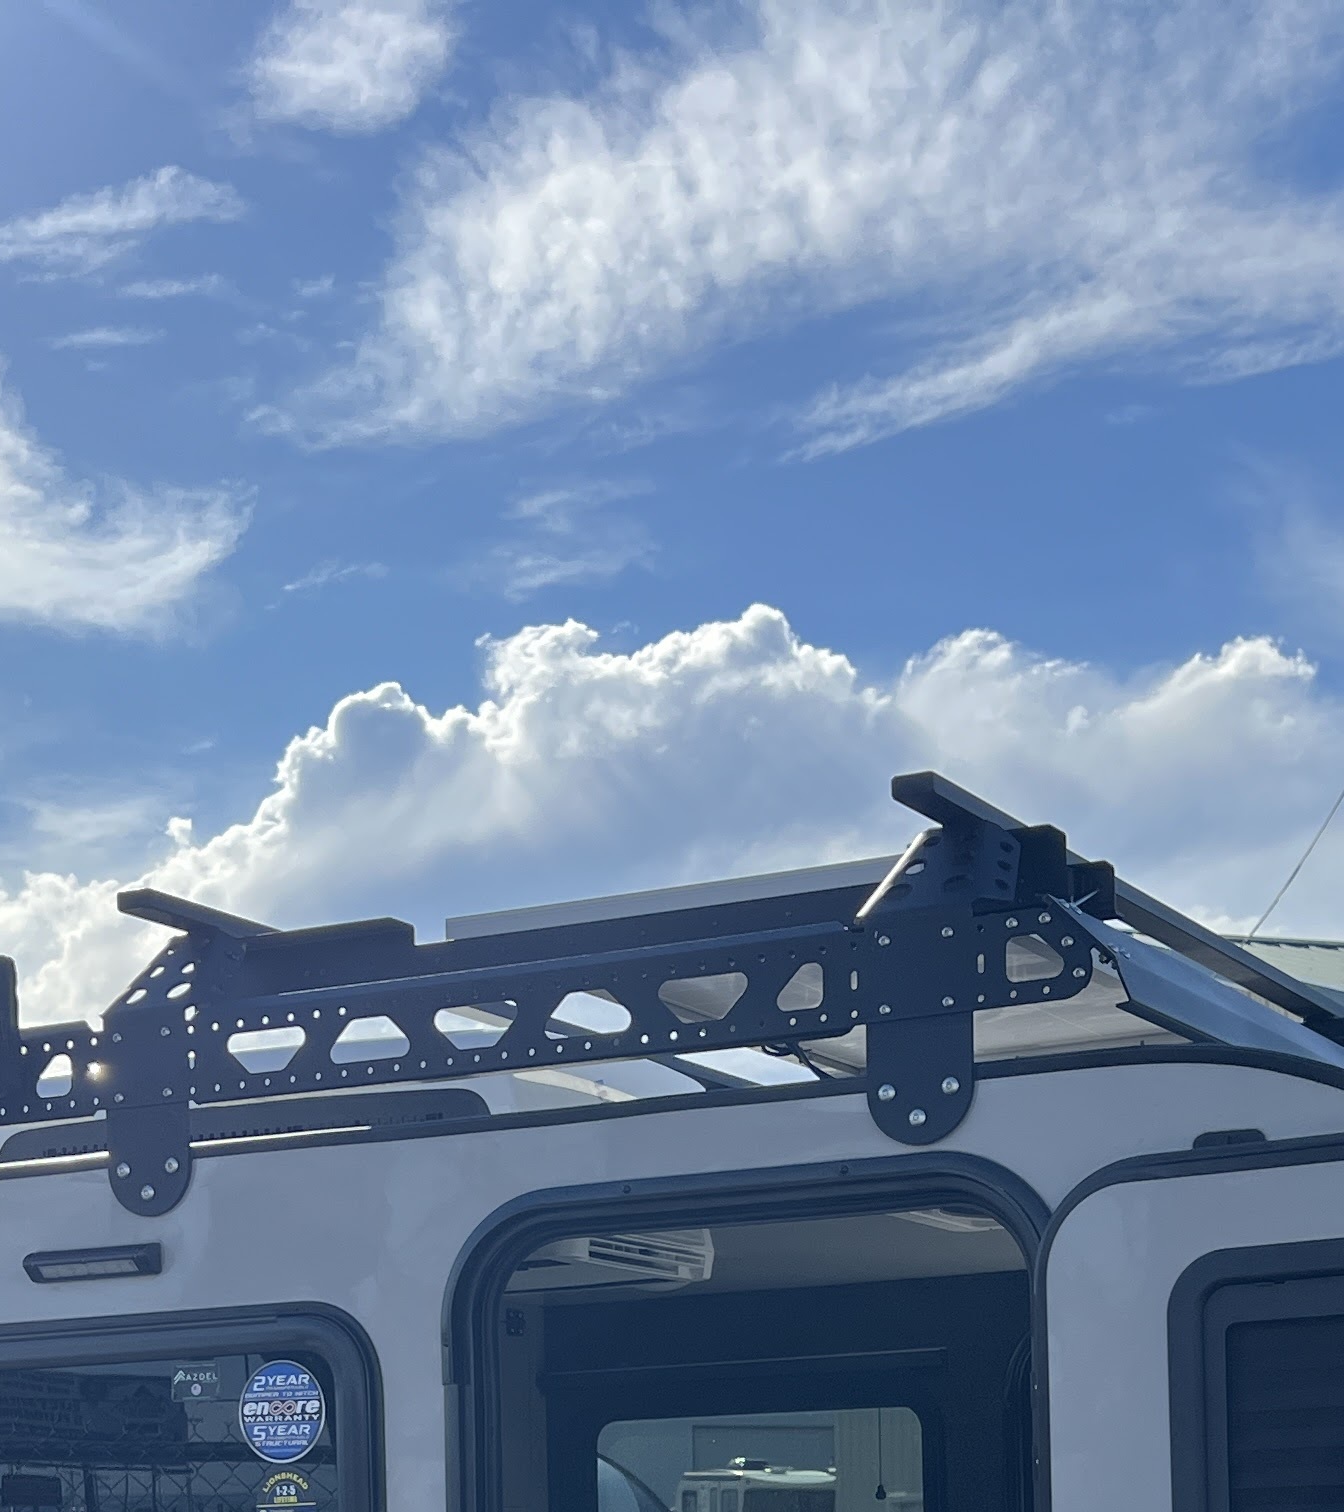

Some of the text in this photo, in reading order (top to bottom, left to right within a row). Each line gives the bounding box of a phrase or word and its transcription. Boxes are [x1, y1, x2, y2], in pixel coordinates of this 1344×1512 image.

[253, 1374, 310, 1391] 2 YEAR
[243, 1414, 320, 1423] WARRANTY
[252, 1424, 311, 1441] 5 YEAR
[262, 1472, 309, 1493] LIONSHEAD
